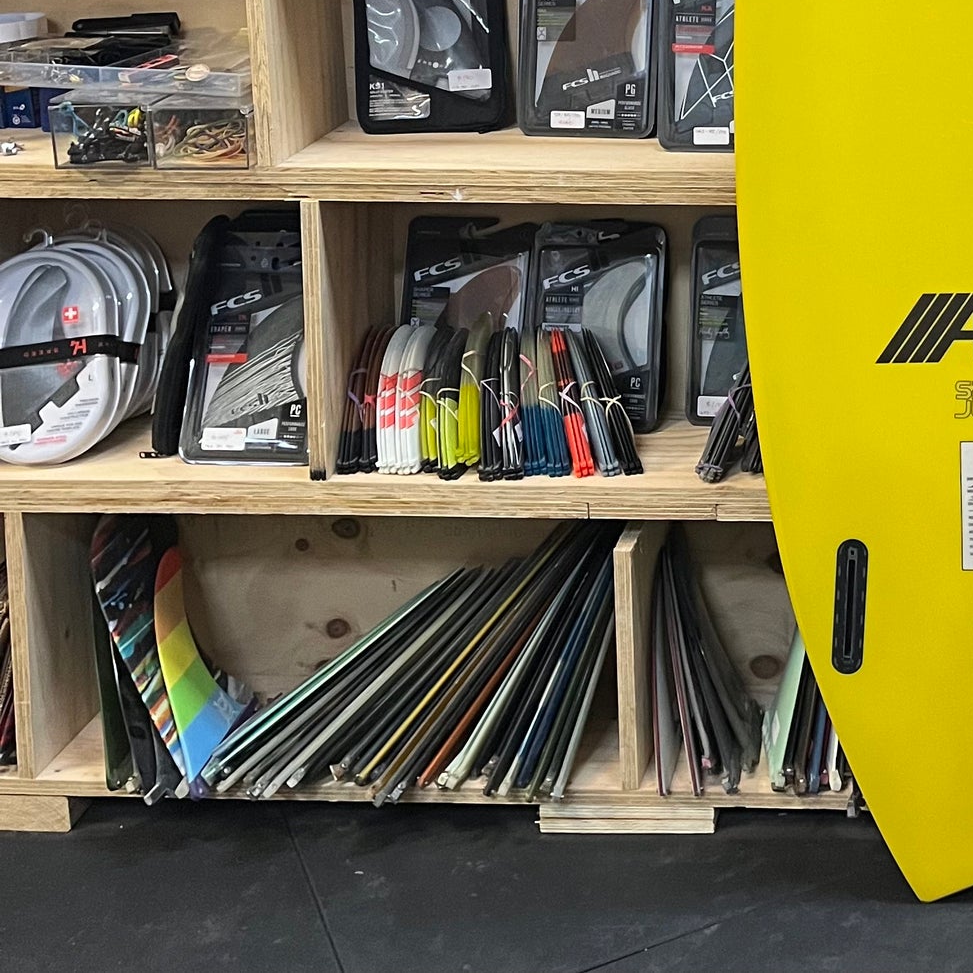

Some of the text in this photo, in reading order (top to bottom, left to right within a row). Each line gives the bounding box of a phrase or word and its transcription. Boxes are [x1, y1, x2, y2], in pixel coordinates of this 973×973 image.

[625, 83, 636, 95] PG
[414, 257, 461, 282] FCS
[542, 264, 591, 290] FCS
[210, 289, 262, 315] FCS
[630, 376, 641, 388] PC
[289, 404, 302, 415] PC
